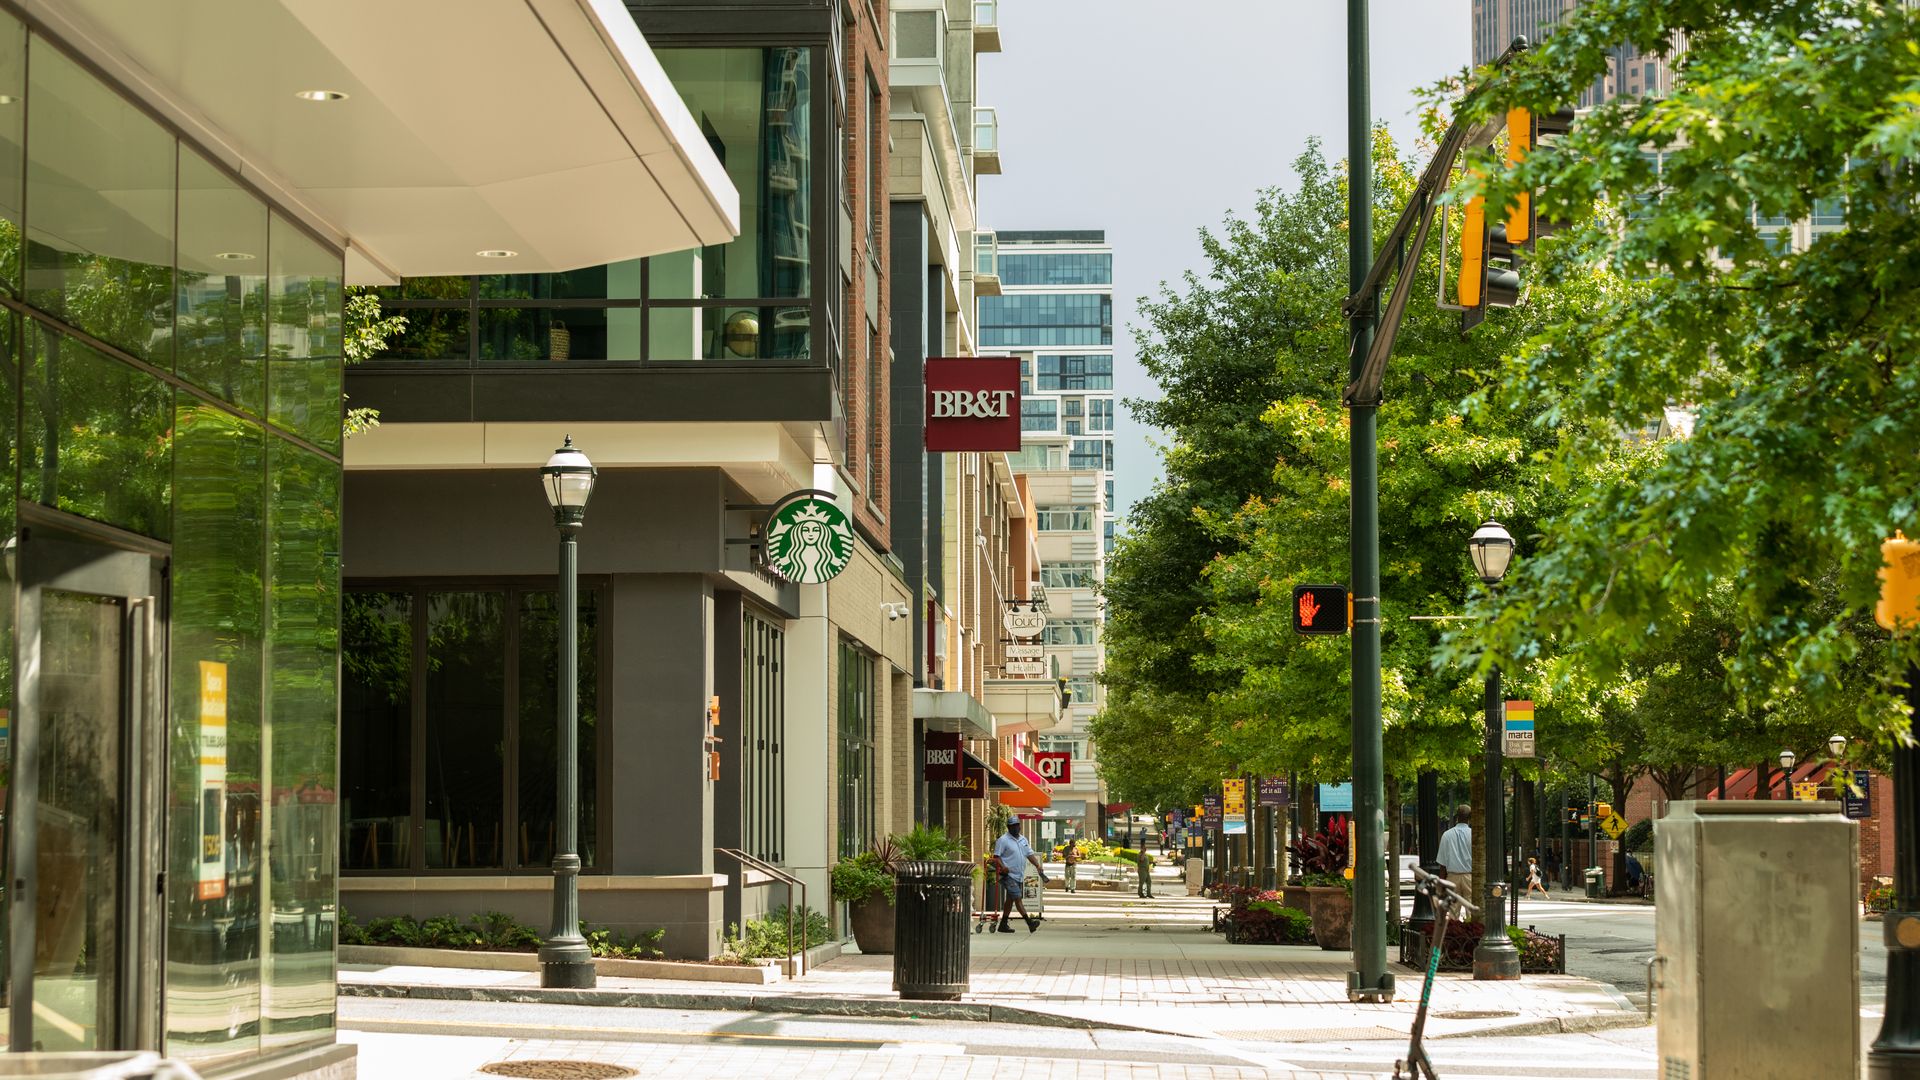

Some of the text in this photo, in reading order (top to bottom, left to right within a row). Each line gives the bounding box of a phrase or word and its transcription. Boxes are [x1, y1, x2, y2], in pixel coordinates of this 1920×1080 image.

[931, 389, 1015, 418] BB&T
[1008, 612, 1043, 628] Touch
[926, 749, 957, 765] BB&T
[1038, 757, 1065, 778] QT
